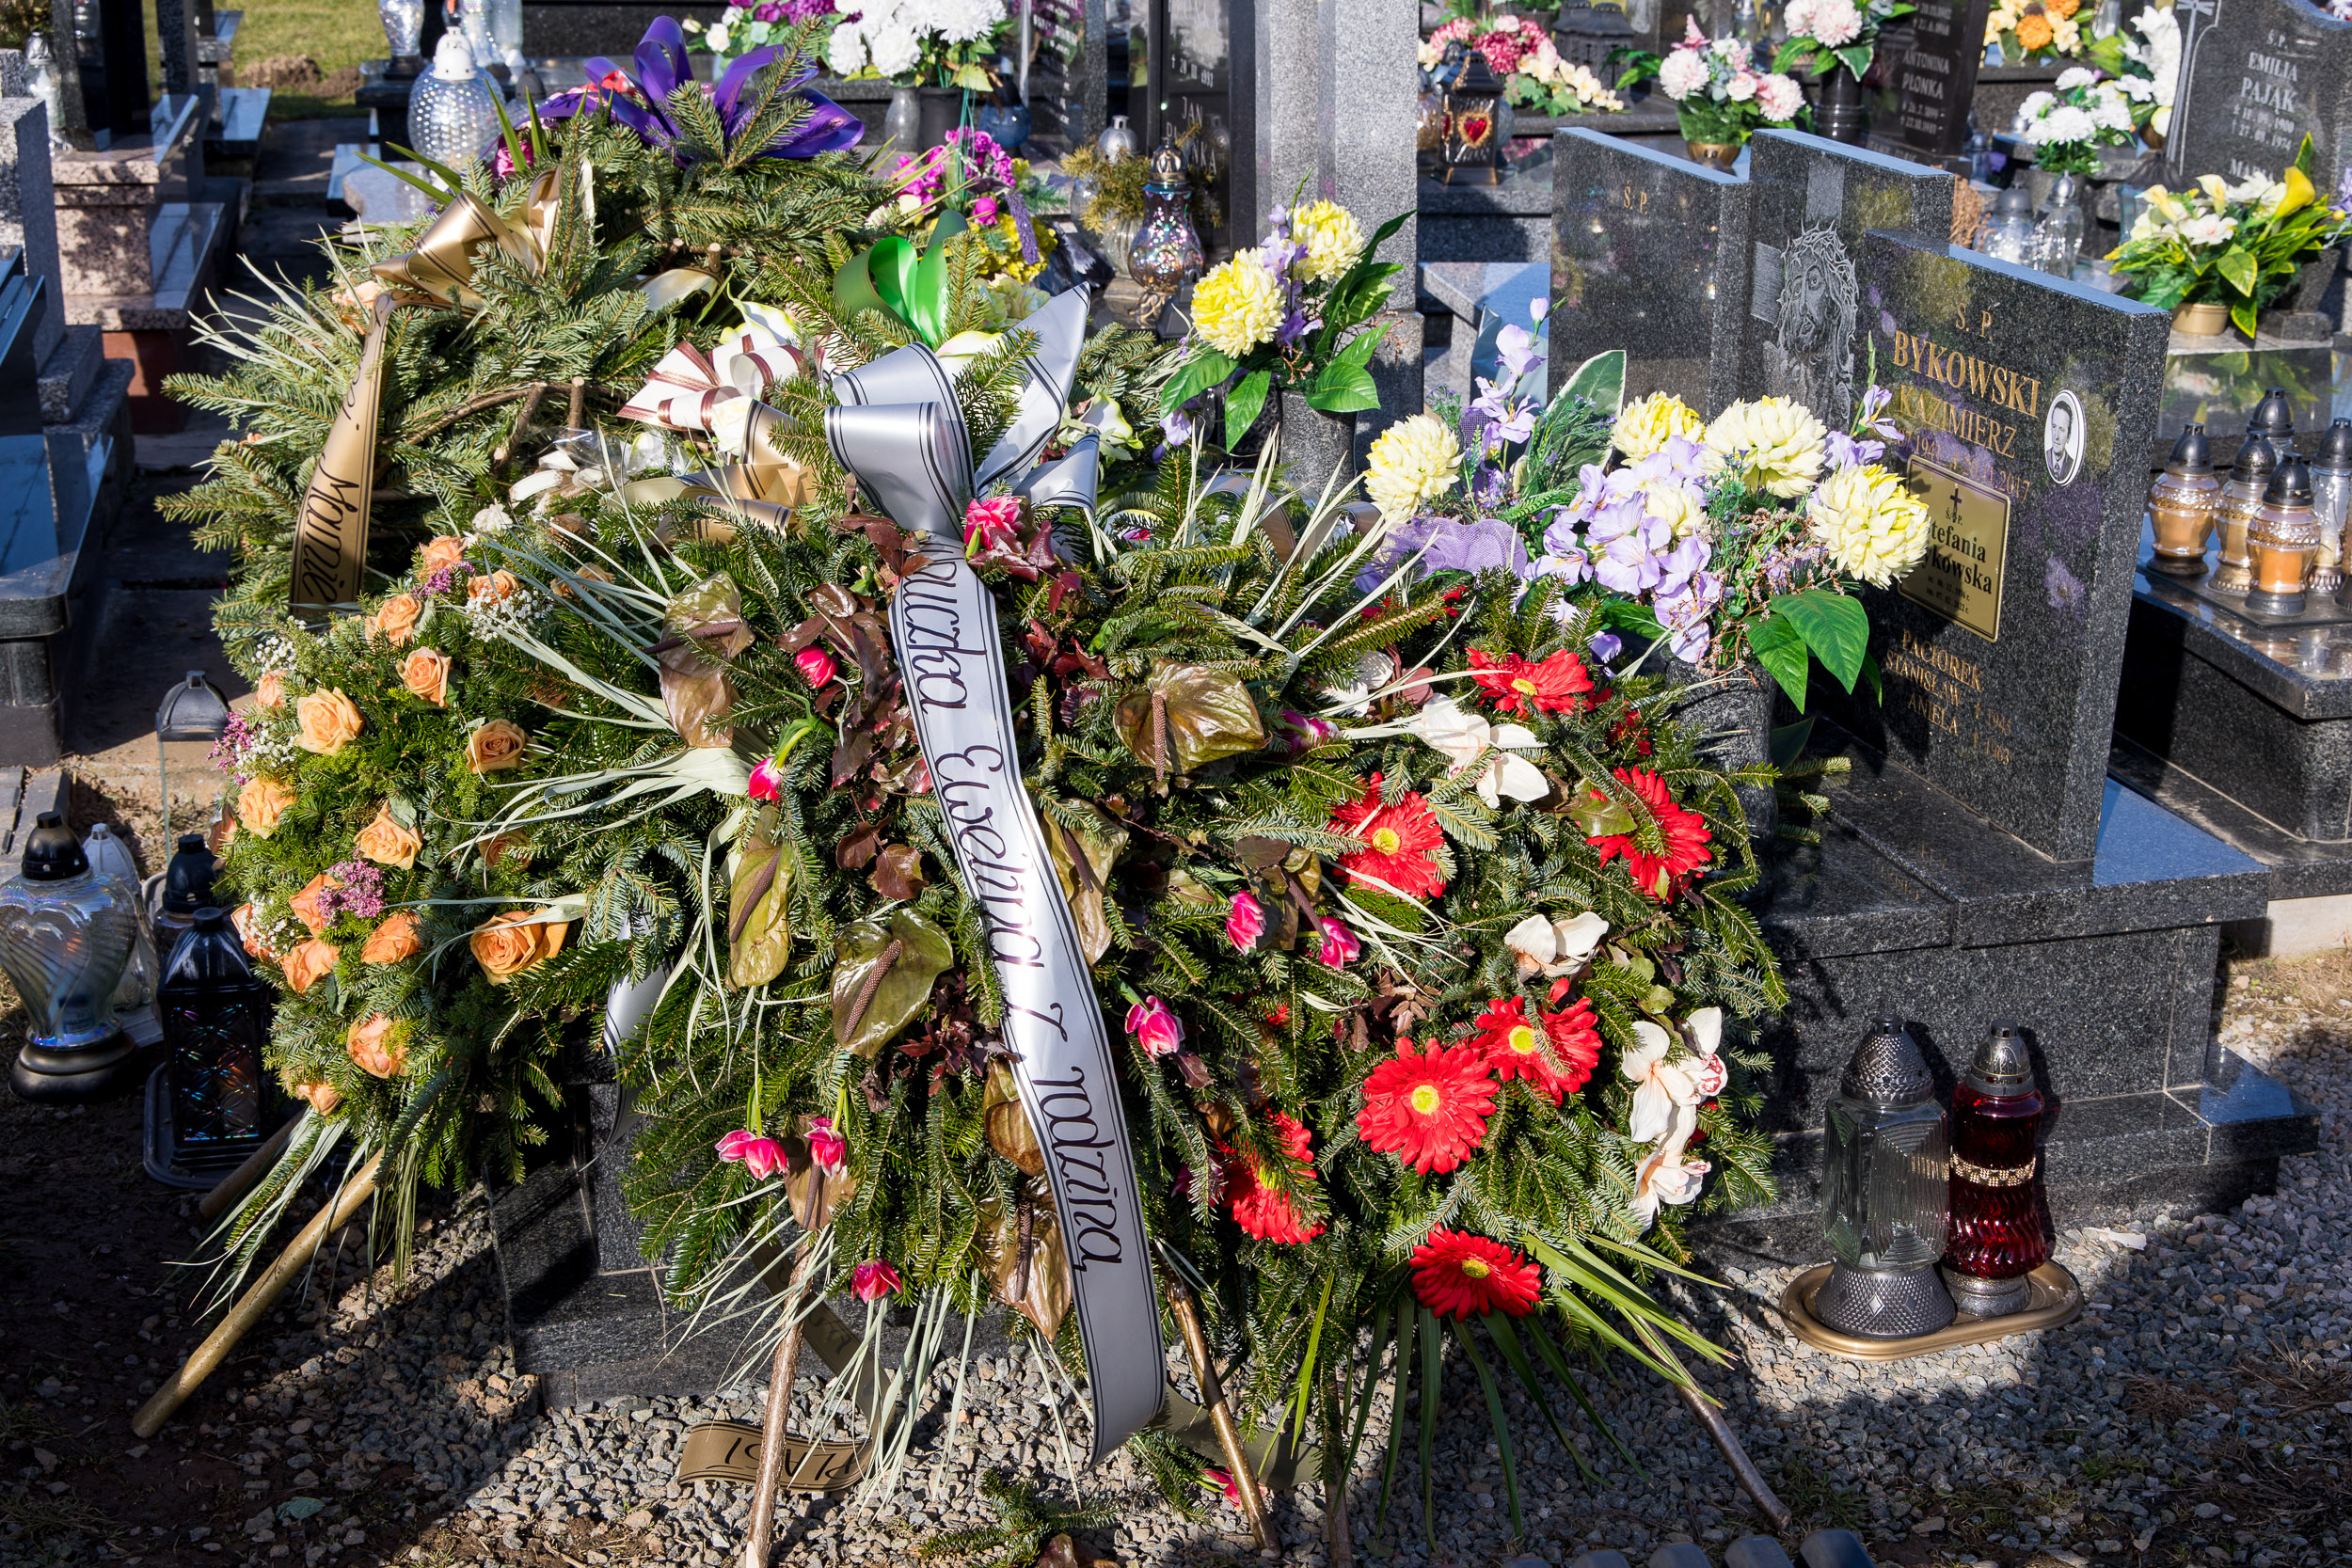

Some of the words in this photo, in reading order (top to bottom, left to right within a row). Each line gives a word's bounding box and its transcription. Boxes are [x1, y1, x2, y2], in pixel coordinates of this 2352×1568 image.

[2248, 51, 2297, 82] EMILIA
[1182, 96, 1203, 128] JAN
[2241, 77, 2297, 115] PAJĄK
[1892, 330, 2042, 419] BYKOWSKI
[1899, 384, 2017, 459] KAZIMIERZ
[301, 453, 360, 603] Mamie
[1929, 520, 1986, 562] tefania
[1922, 545, 1992, 594] ykowska
[1885, 649, 1964, 707] STANISŁAW
[1902, 628, 1984, 693] PACIOREK
[1907, 692, 1959, 737] ANIELA
[934, 745, 1045, 969] Ewelina
